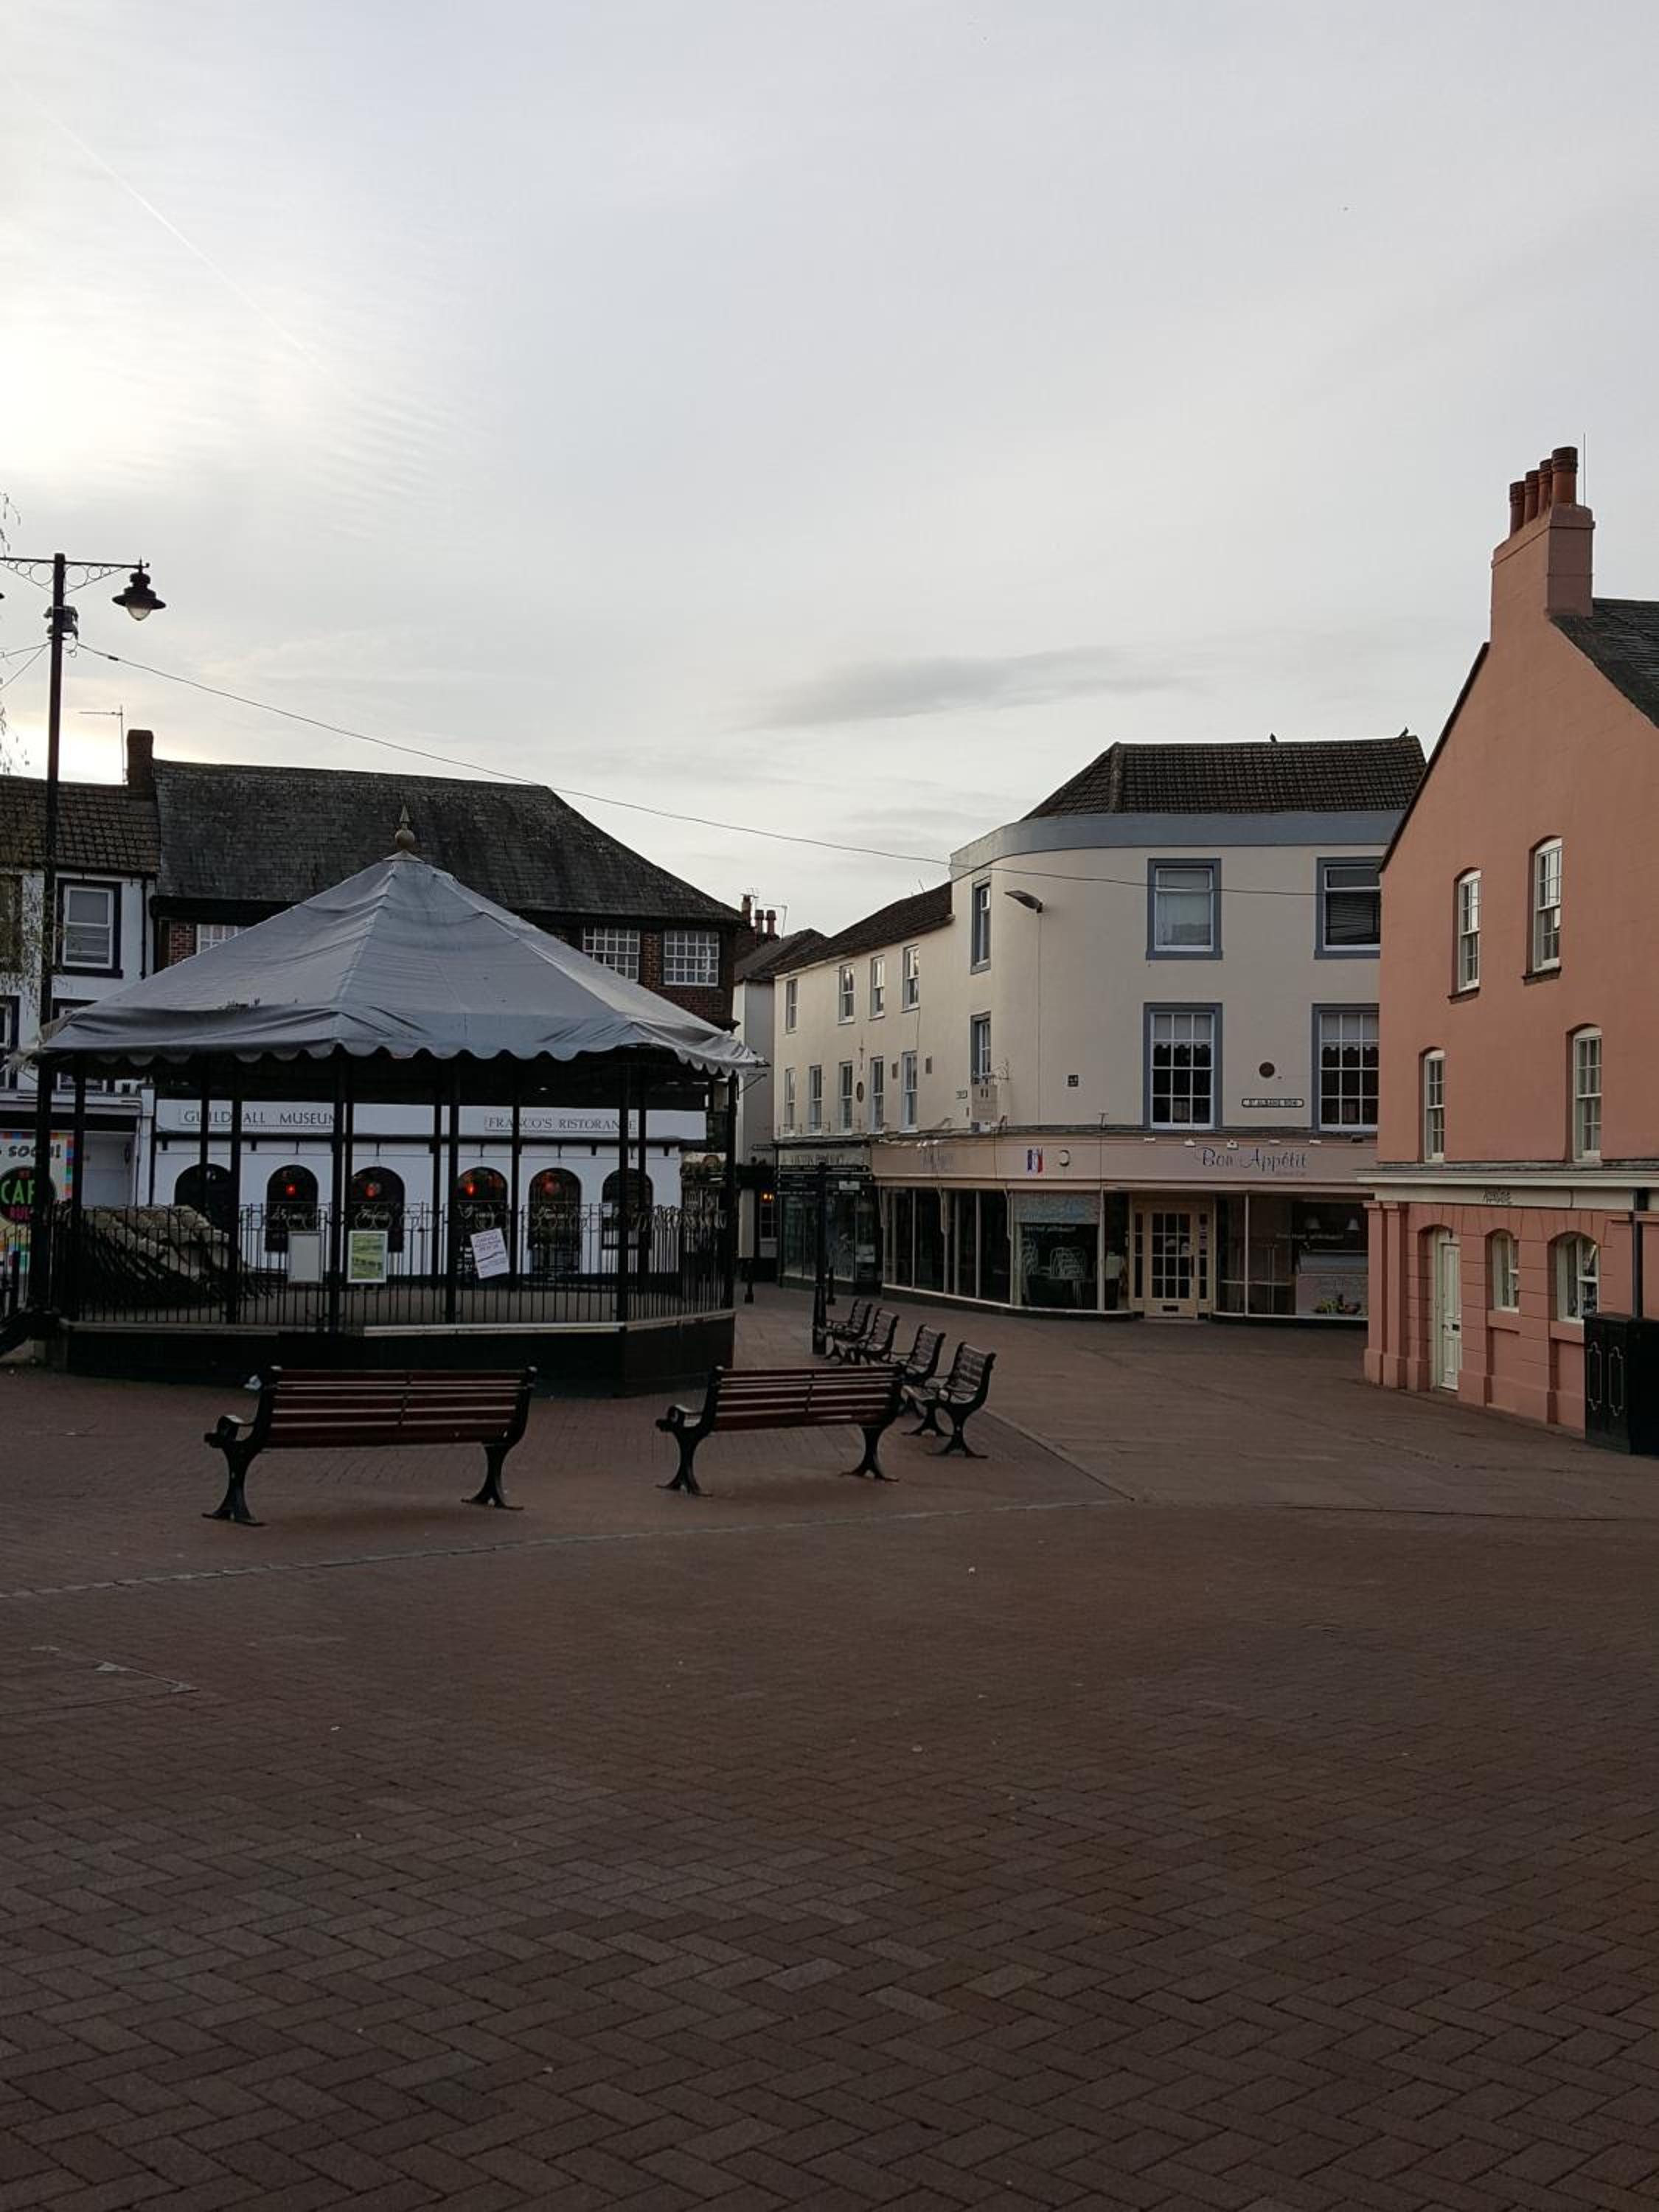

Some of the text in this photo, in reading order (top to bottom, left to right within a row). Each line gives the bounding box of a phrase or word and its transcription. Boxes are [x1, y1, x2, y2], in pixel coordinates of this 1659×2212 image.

[183, 1110, 266, 1124] GILDALL
[488, 1116, 638, 1131] FRACO'S RISTORANE
[1196, 1147, 1309, 1172] Bon Appétit
[1, 1179, 36, 1204] CAF
